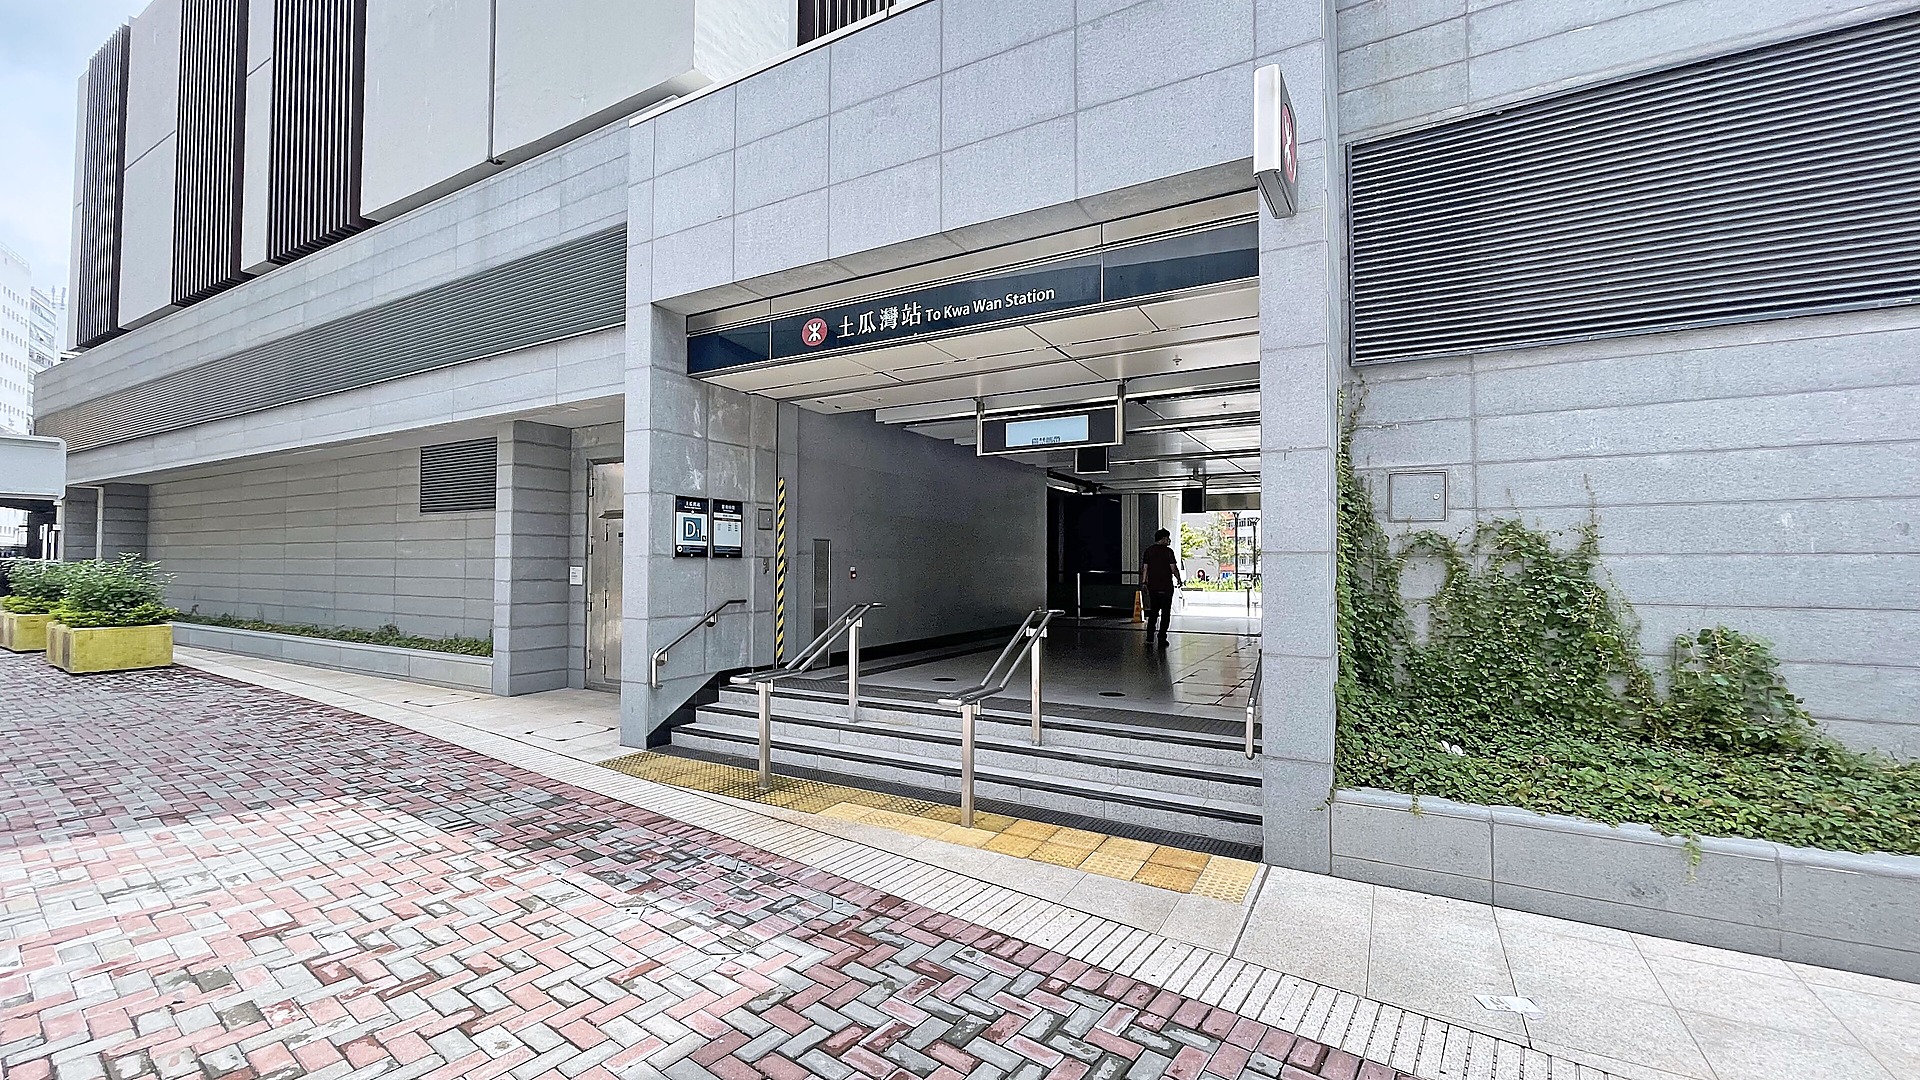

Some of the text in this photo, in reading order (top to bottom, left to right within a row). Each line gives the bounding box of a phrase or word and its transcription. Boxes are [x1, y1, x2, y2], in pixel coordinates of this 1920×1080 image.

[837, 302, 921, 339] 土瓜灣站
[925, 288, 1055, 323] To Kwa Wan Station
